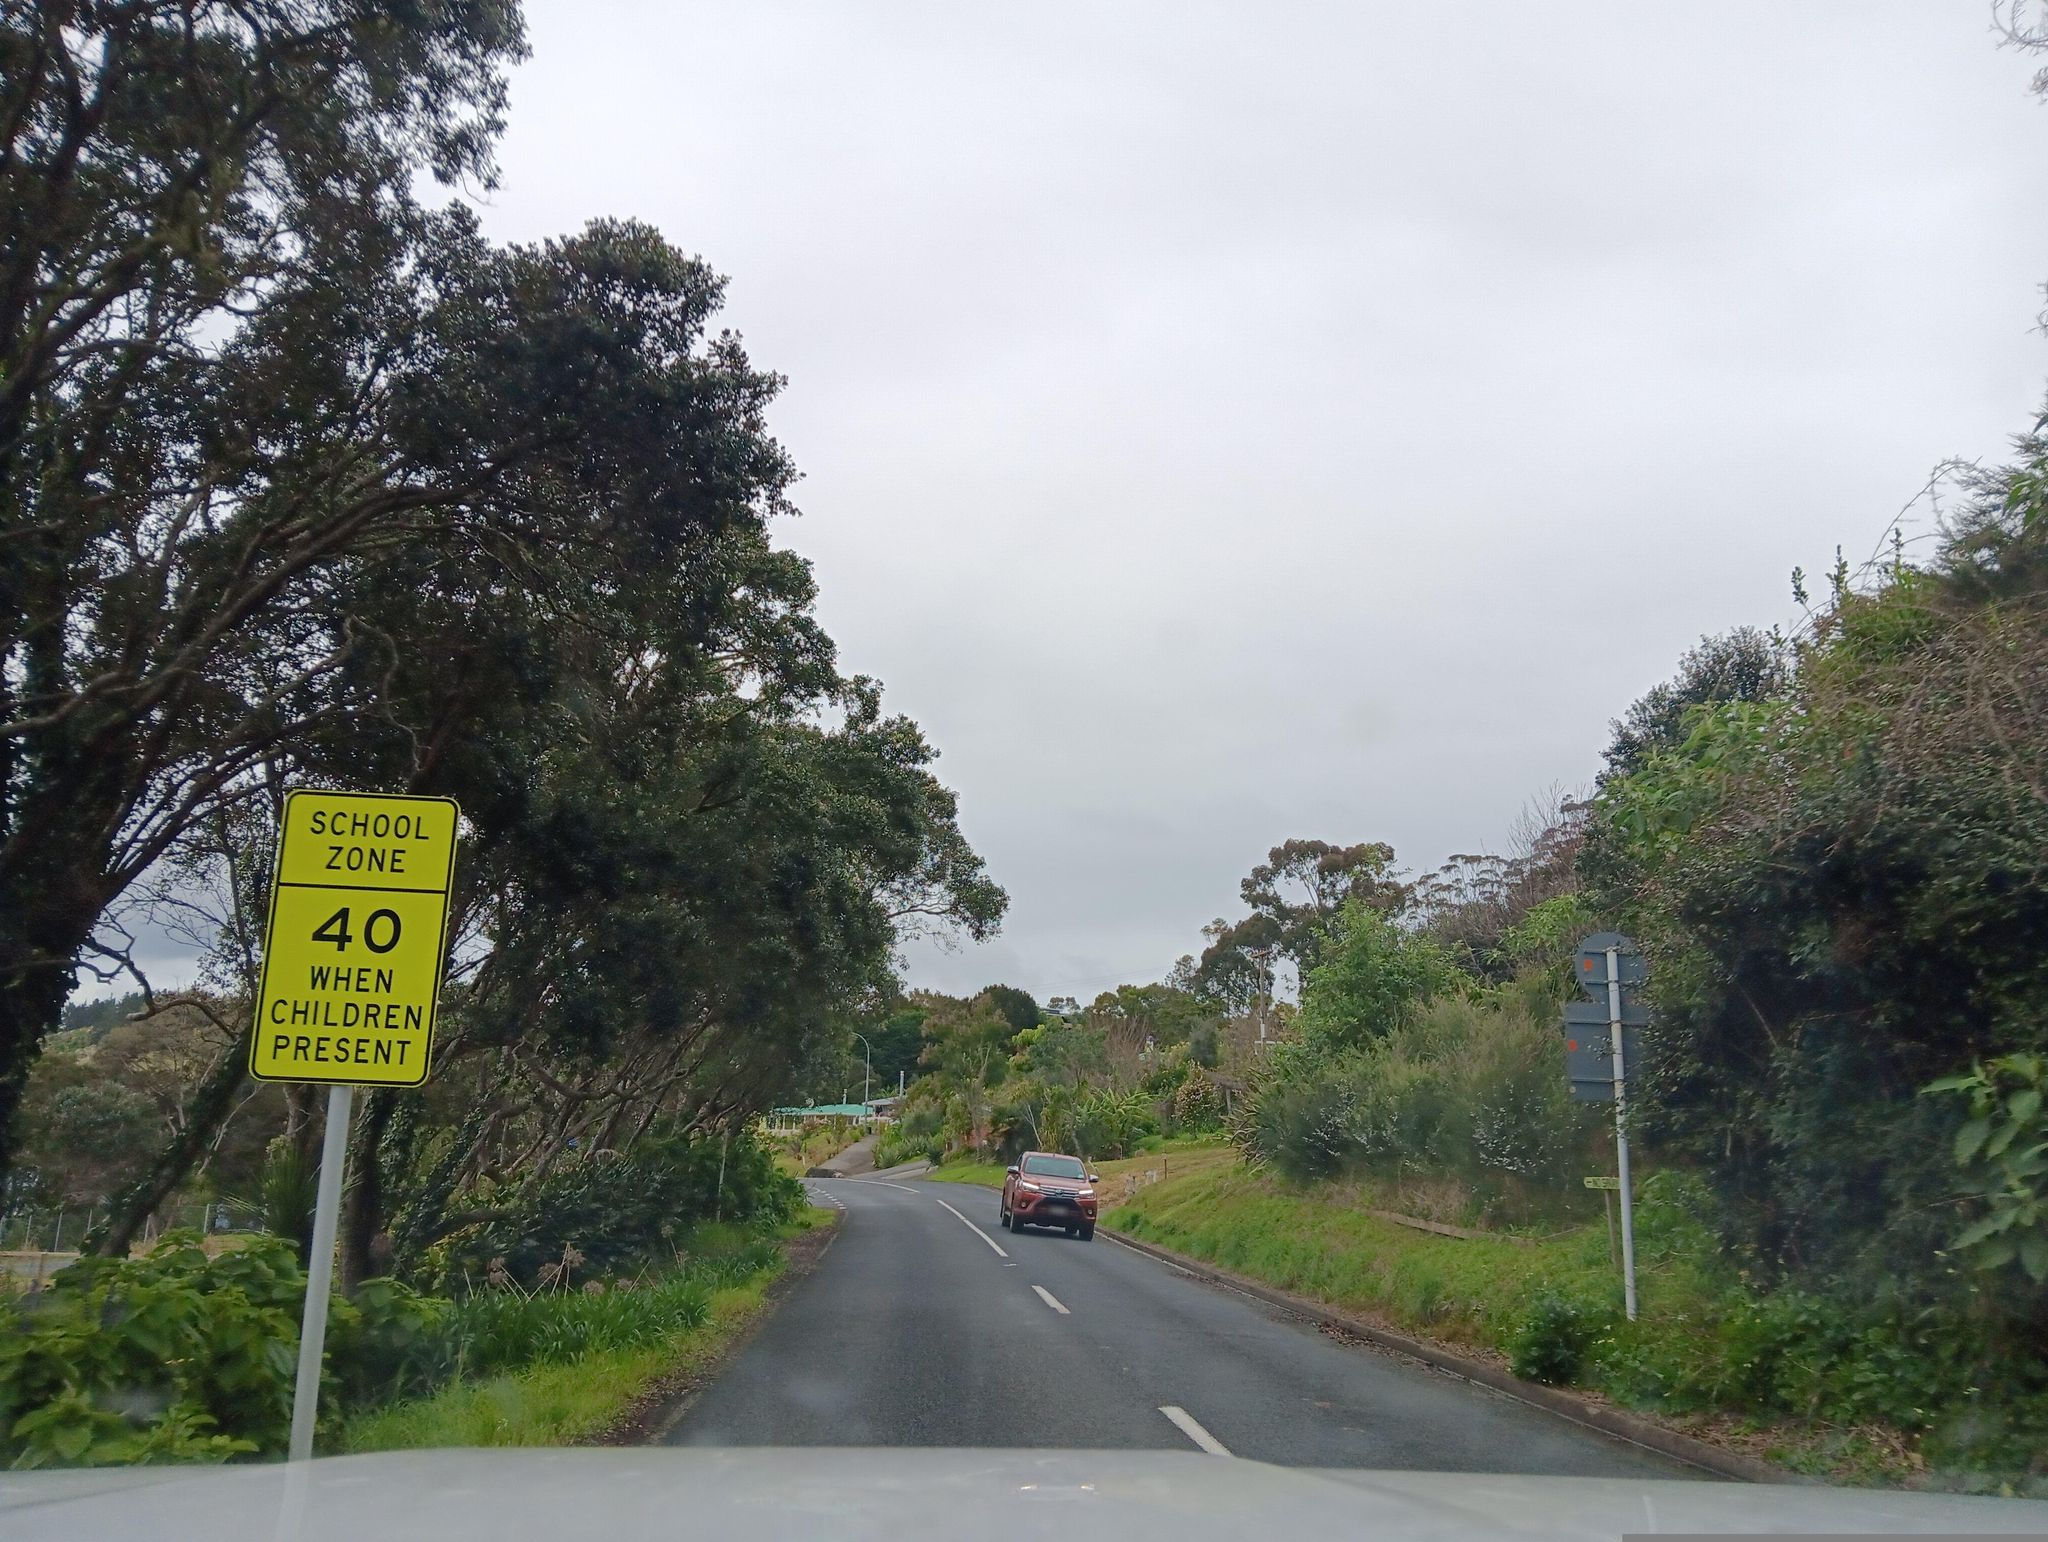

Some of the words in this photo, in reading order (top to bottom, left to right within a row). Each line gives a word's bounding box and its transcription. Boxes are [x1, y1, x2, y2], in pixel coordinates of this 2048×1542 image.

[310, 810, 429, 840] SCHOOL
[326, 846, 406, 873] ZONE
[312, 907, 402, 954] 40
[310, 966, 393, 993] WHEN
[271, 999, 422, 1030] CHILDREN
[272, 1035, 411, 1065] PRESENT
